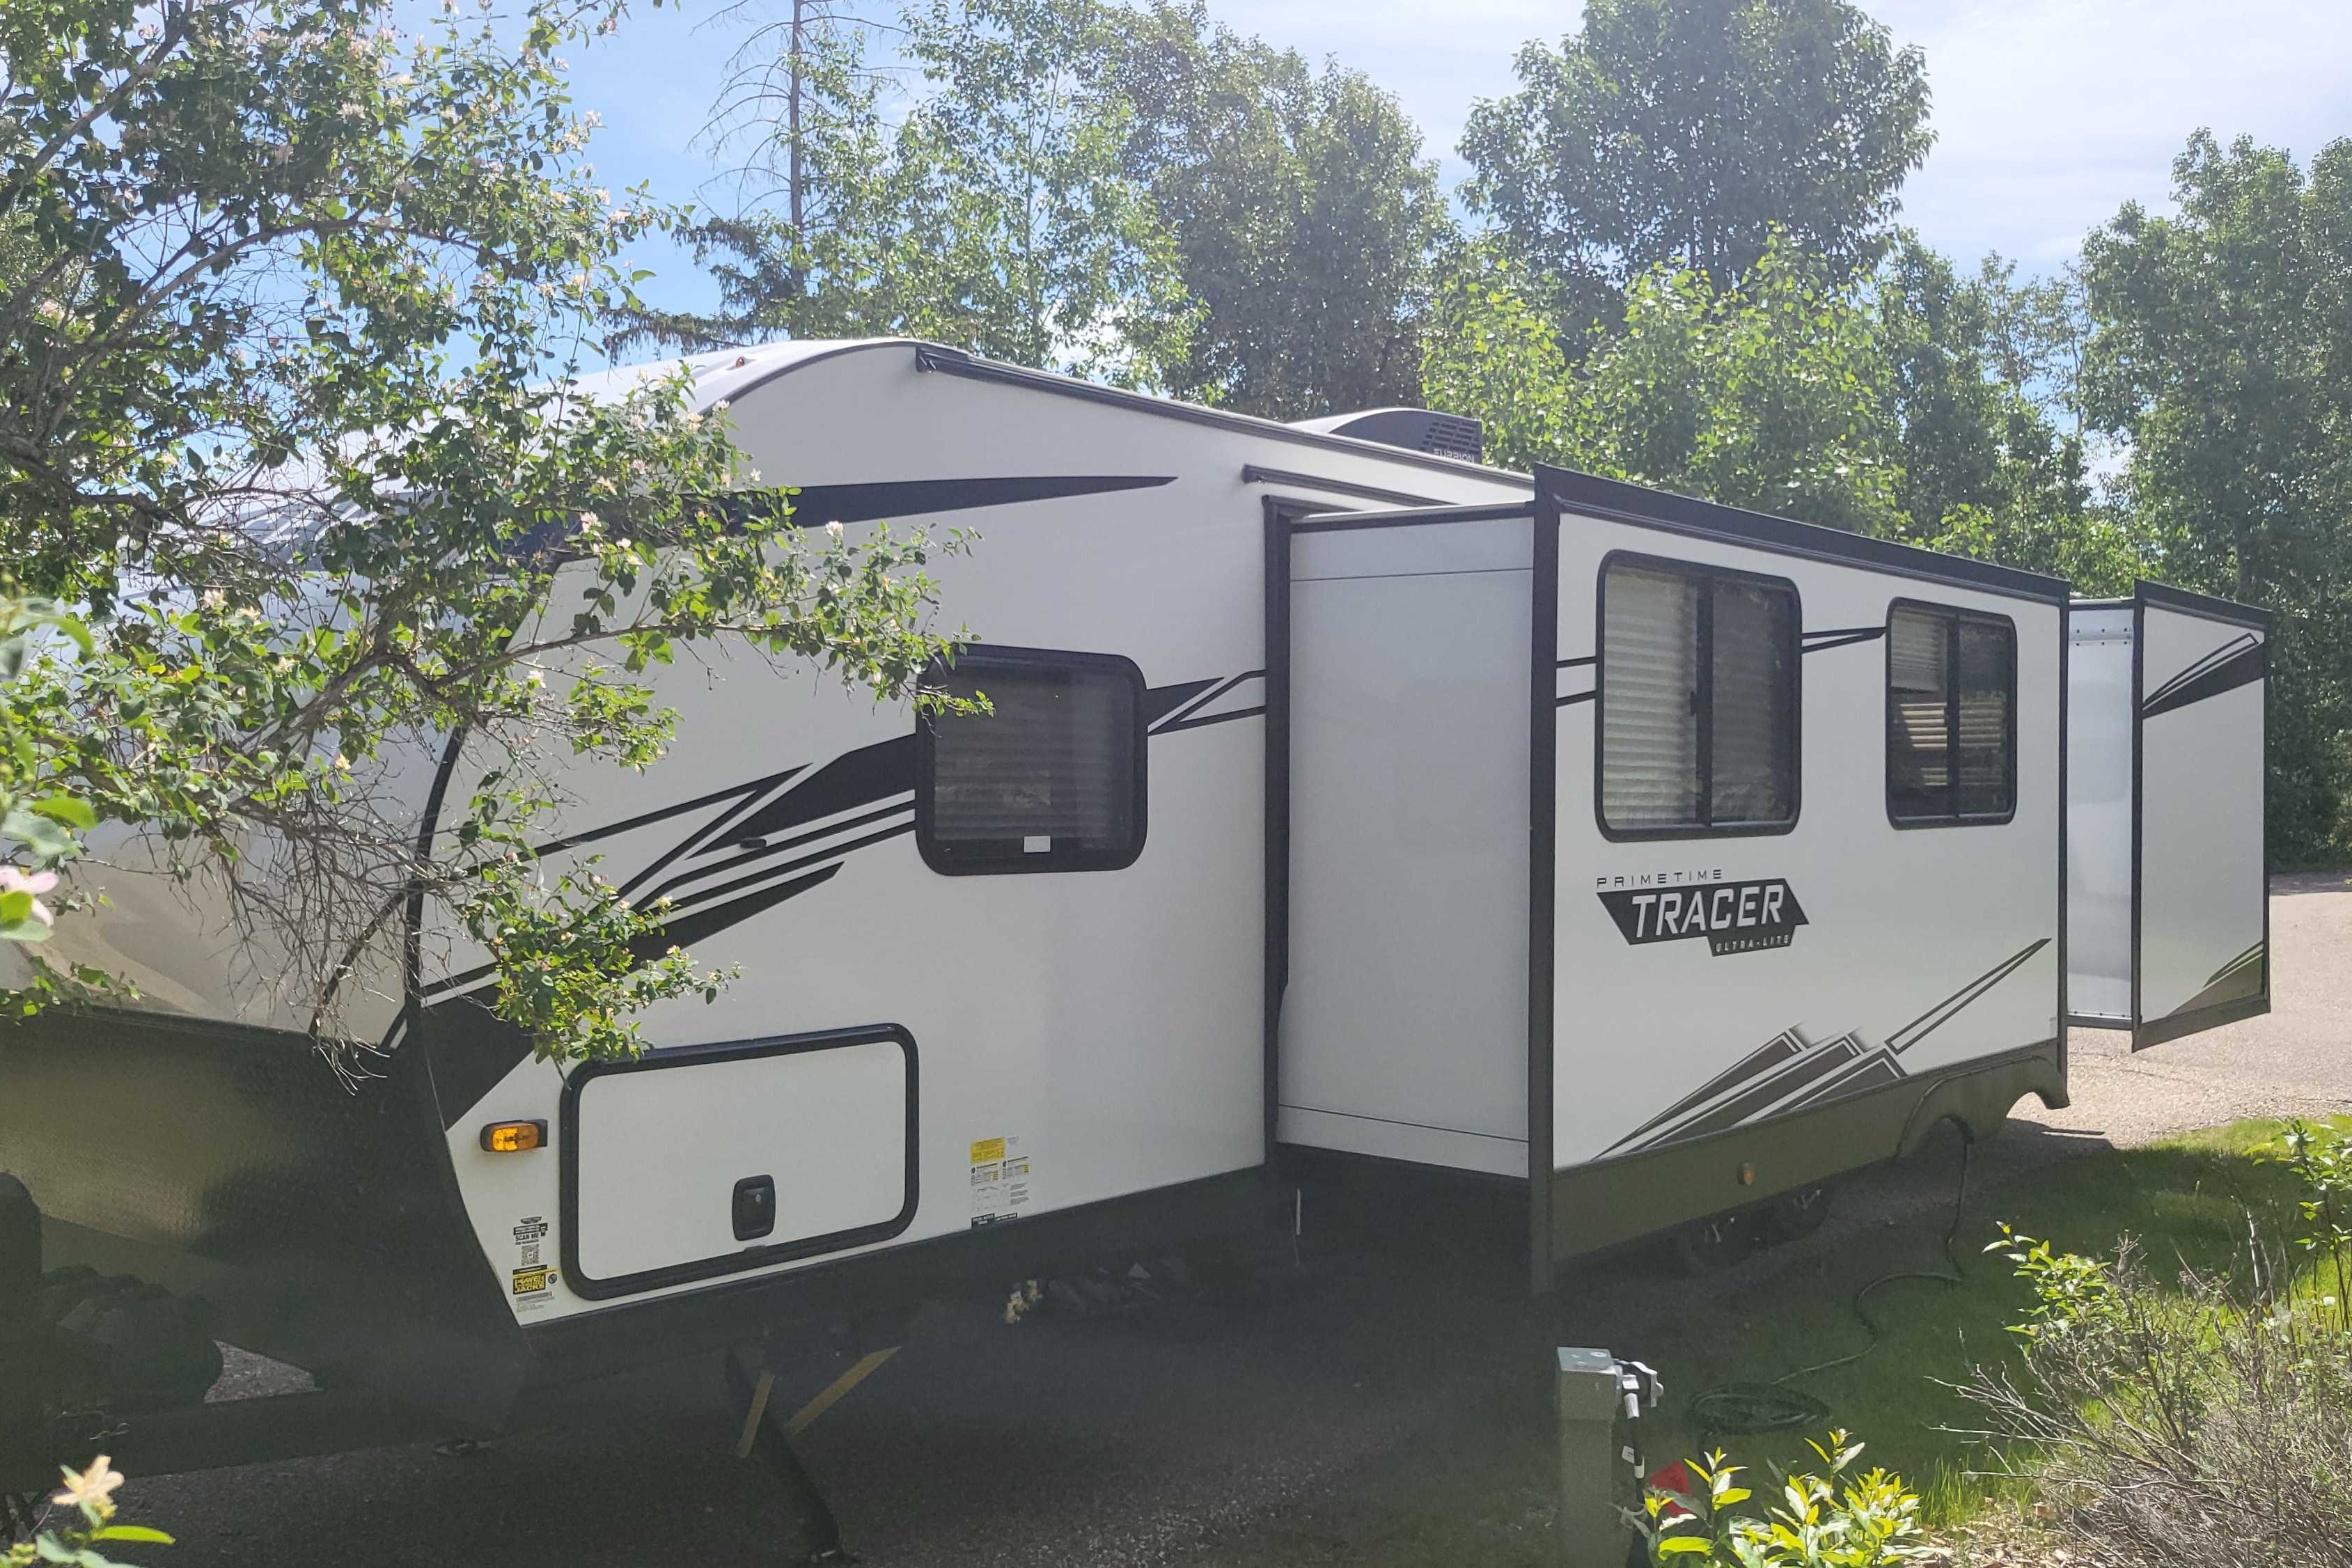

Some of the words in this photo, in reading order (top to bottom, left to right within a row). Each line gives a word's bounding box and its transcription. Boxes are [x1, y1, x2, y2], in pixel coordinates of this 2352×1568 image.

[1597, 869, 1722, 889] PRIMETIME
[1631, 884, 1784, 938] TRACER
[1716, 934, 1789, 952] ULTRA-LITE
